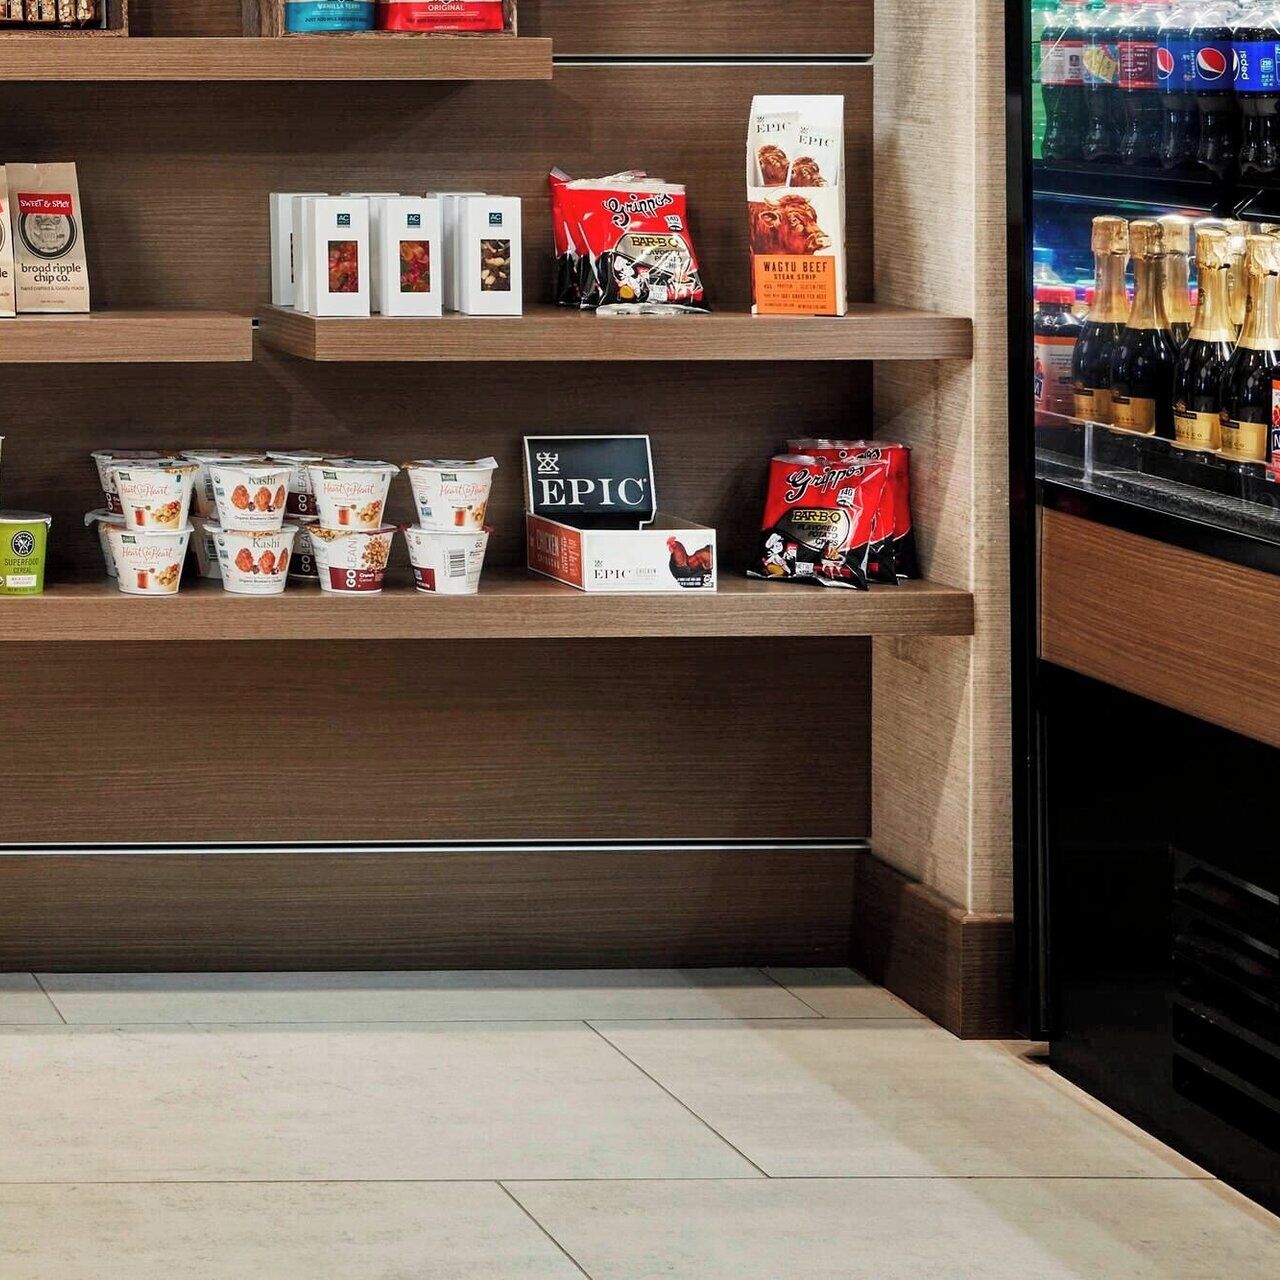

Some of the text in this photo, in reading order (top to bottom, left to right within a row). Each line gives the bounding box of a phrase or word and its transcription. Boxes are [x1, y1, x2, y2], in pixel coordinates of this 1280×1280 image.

[1240, 51, 1249, 80] pepsi
[756, 122, 792, 134] EPIC
[799, 135, 835, 147] EPIC
[763, 261, 827, 272] WAGYU BEEF
[248, 475, 276, 486] Kashi
[537, 478, 644, 505] EPIC
[793, 511, 841, 522] BAR-B-Q
[252, 538, 280, 549] Kashi
[122, 547, 141, 557] Heart
[151, 548, 173, 559] Heart
[301, 555, 311, 572] GO
